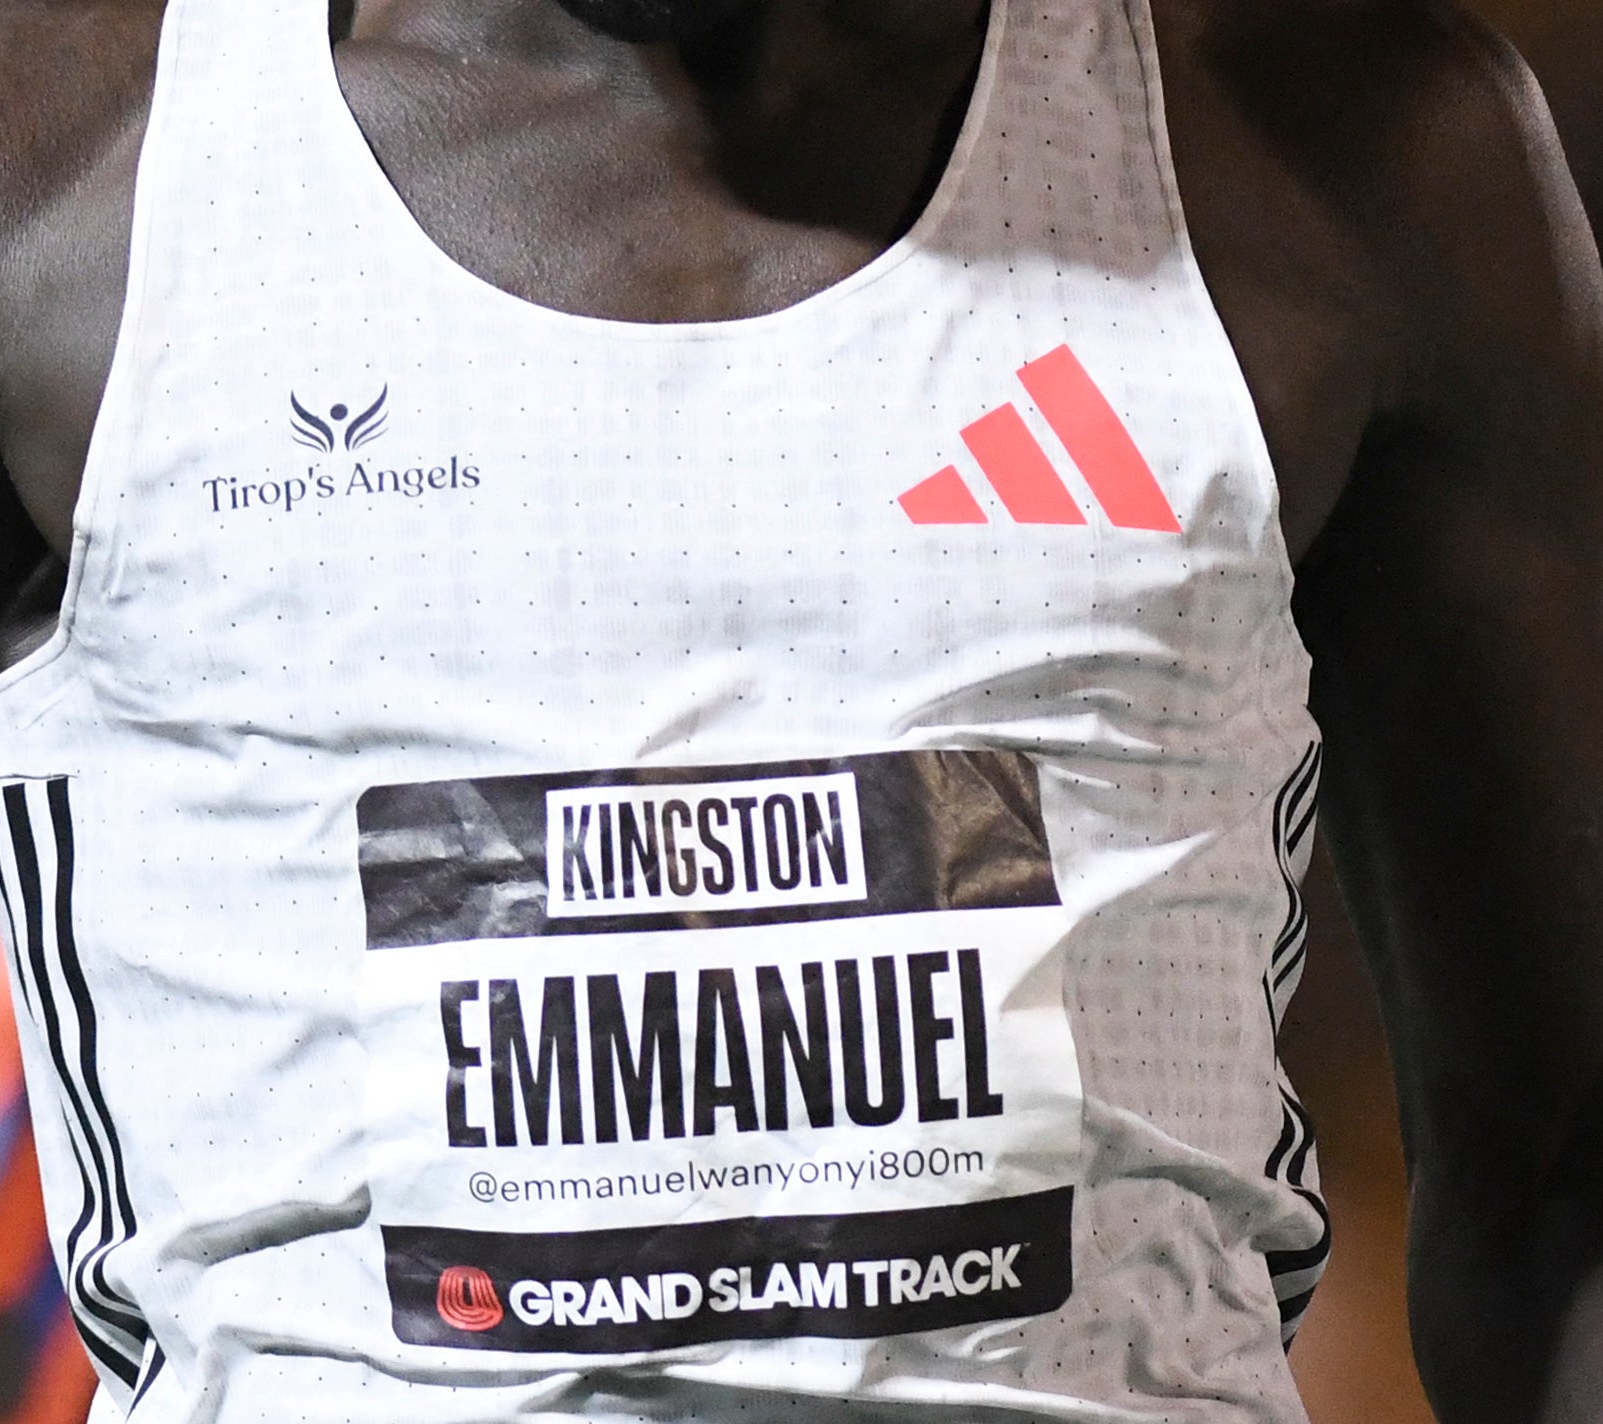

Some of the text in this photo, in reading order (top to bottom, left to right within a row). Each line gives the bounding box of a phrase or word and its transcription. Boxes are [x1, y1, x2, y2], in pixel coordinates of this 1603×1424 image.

[201, 455, 481, 513] Tirop's Angels
[560, 790, 849, 901] KINGSTON
[440, 948, 1004, 1149] EMMANUEL
[468, 1147, 986, 1204] @emmanuelwanyonyi800m
[508, 1242, 1024, 1327] GRAND SLAM TRACK
